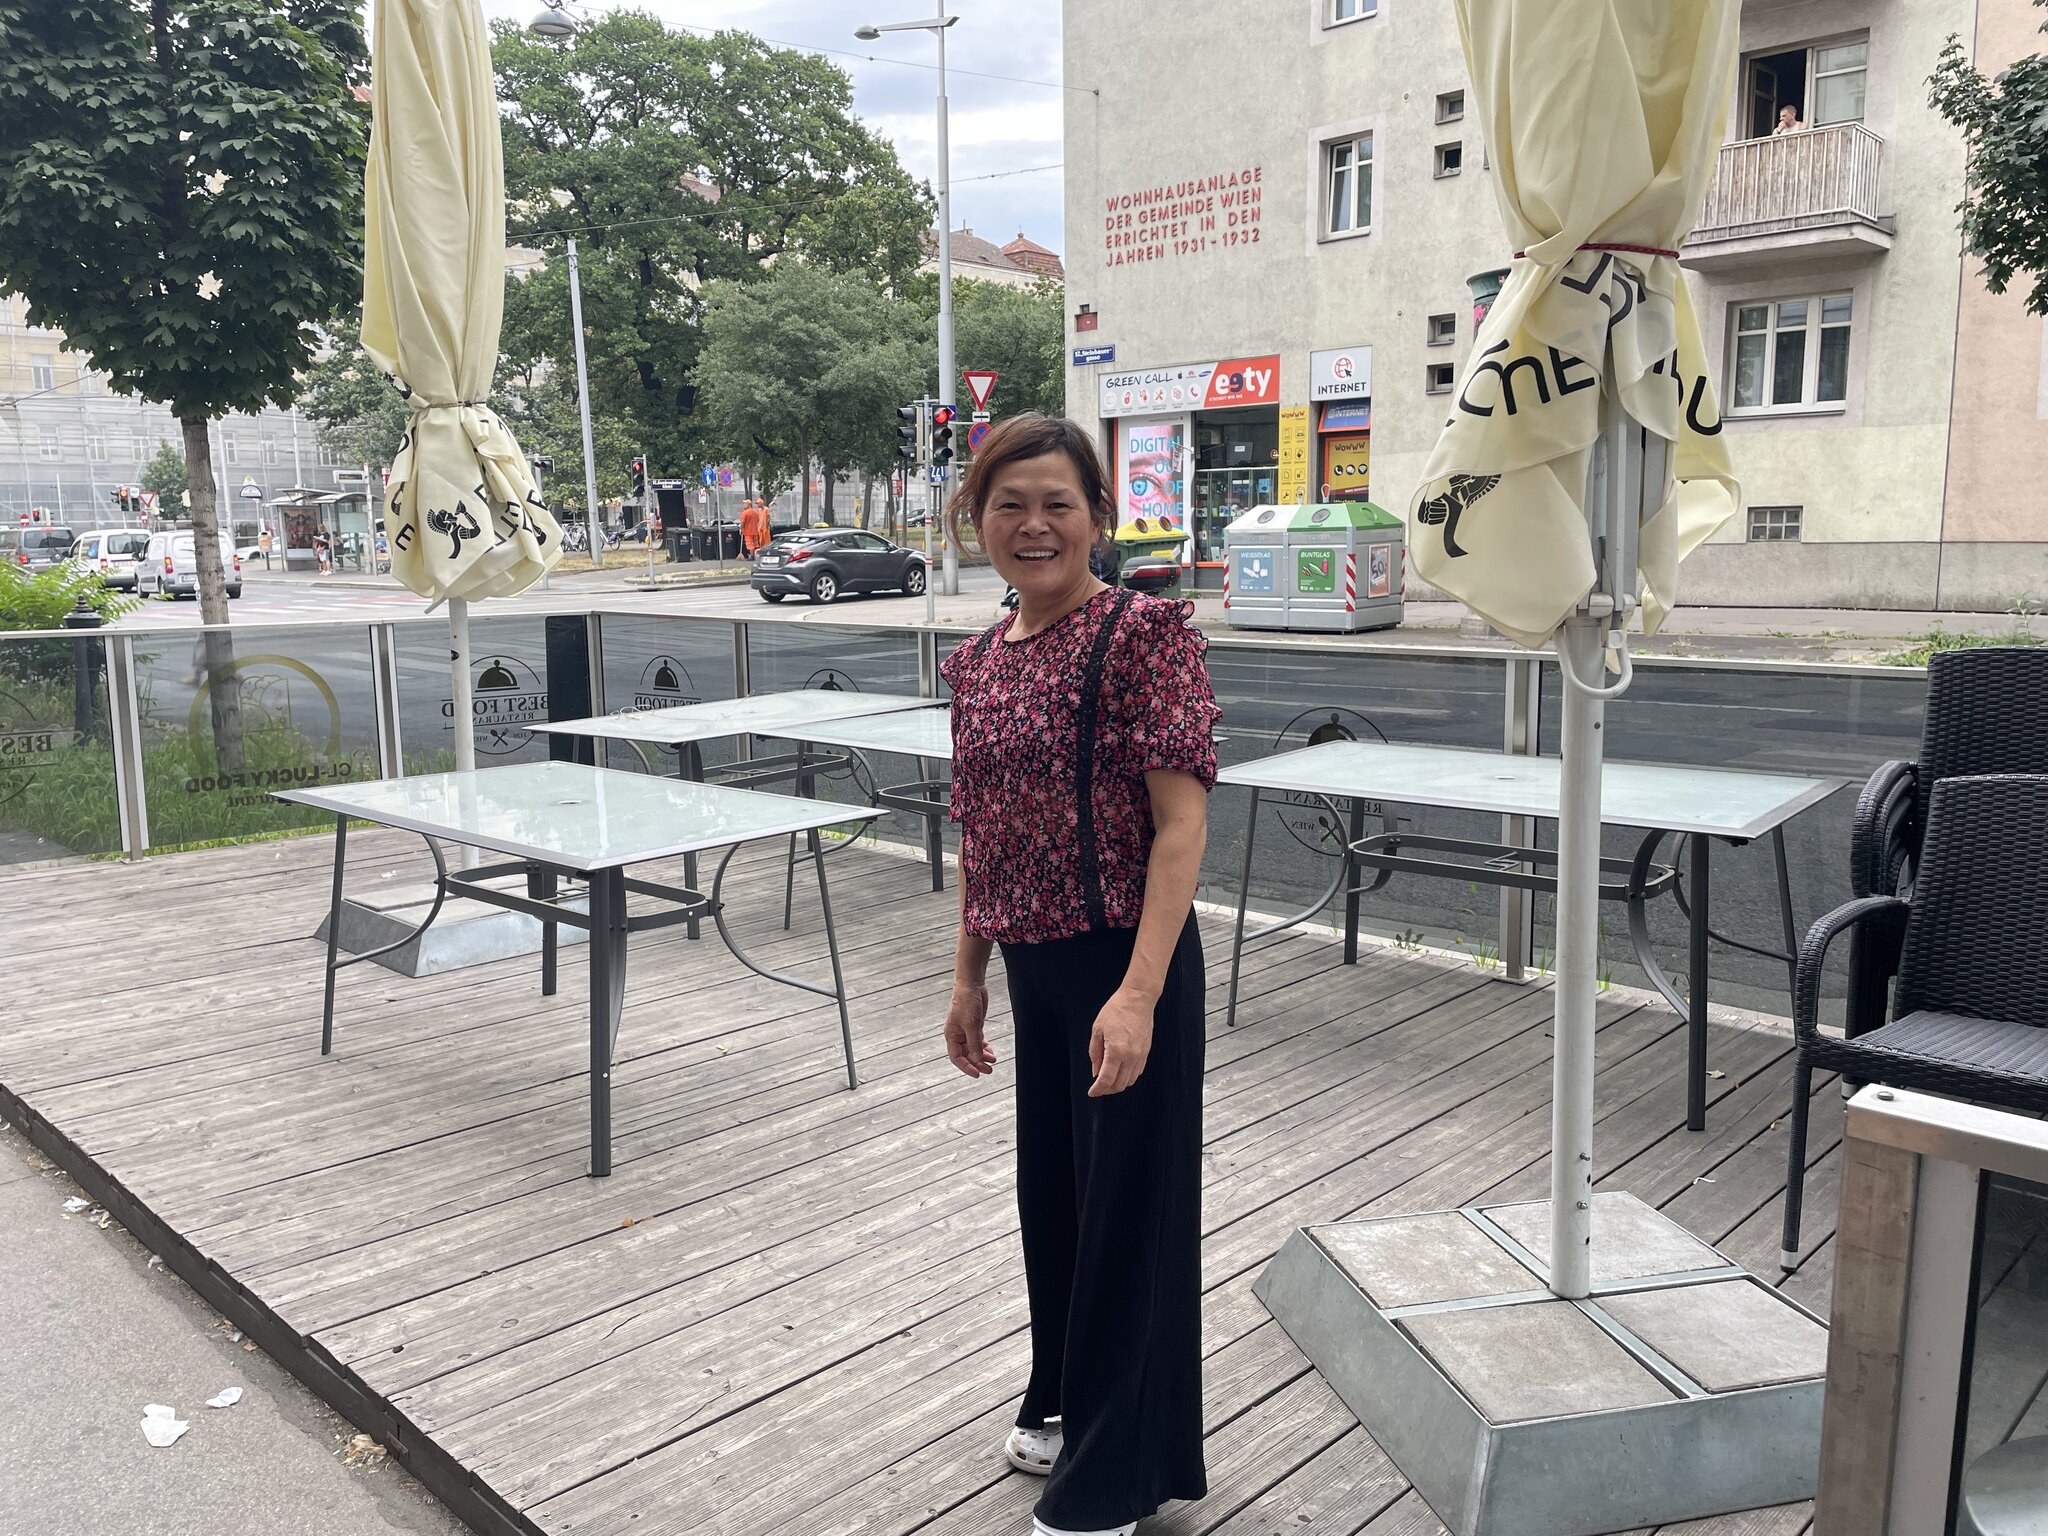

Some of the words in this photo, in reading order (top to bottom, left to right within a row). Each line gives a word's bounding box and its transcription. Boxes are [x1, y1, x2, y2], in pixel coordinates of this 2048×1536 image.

[1105, 166, 1262, 212] WOHNHAUSANLAGE
[1105, 213, 1132, 231] DER
[1138, 196, 1213, 224] GEMEINDE
[1220, 187, 1262, 208] WIEN
[1105, 221, 1188, 249] ERRICHTET
[1200, 215, 1215, 231] IN
[1228, 207, 1261, 226] DEN
[1106, 244, 1164, 267] JAHREN
[1106, 374, 1142, 389] GREEN
[1145, 372, 1173, 385] CALL
[1318, 381, 1367, 395] INTERNET
[1165, 480, 1183, 495] OF
[1142, 501, 1183, 517] HOME
